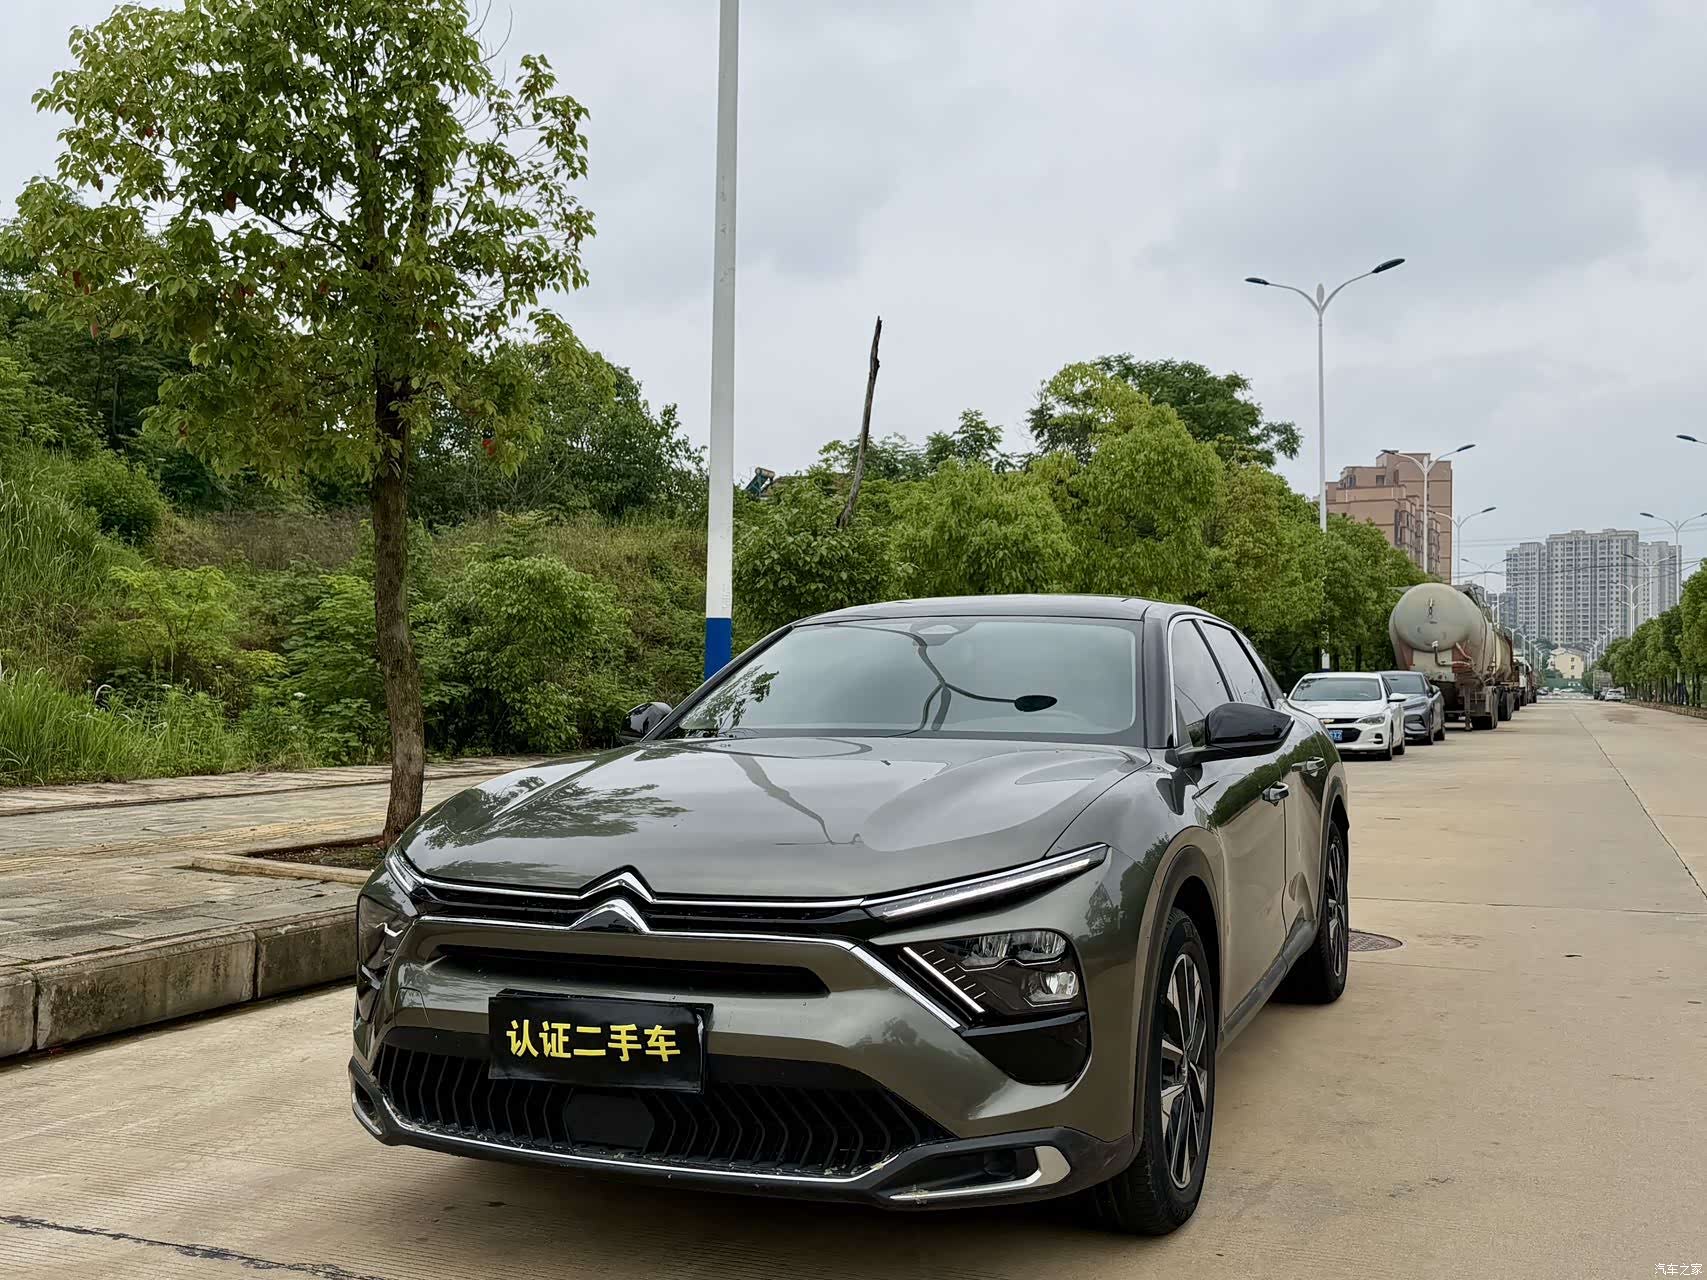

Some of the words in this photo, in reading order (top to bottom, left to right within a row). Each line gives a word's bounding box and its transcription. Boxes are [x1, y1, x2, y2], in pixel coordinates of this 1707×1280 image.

[506, 1019, 681, 1062] 认证二手车
